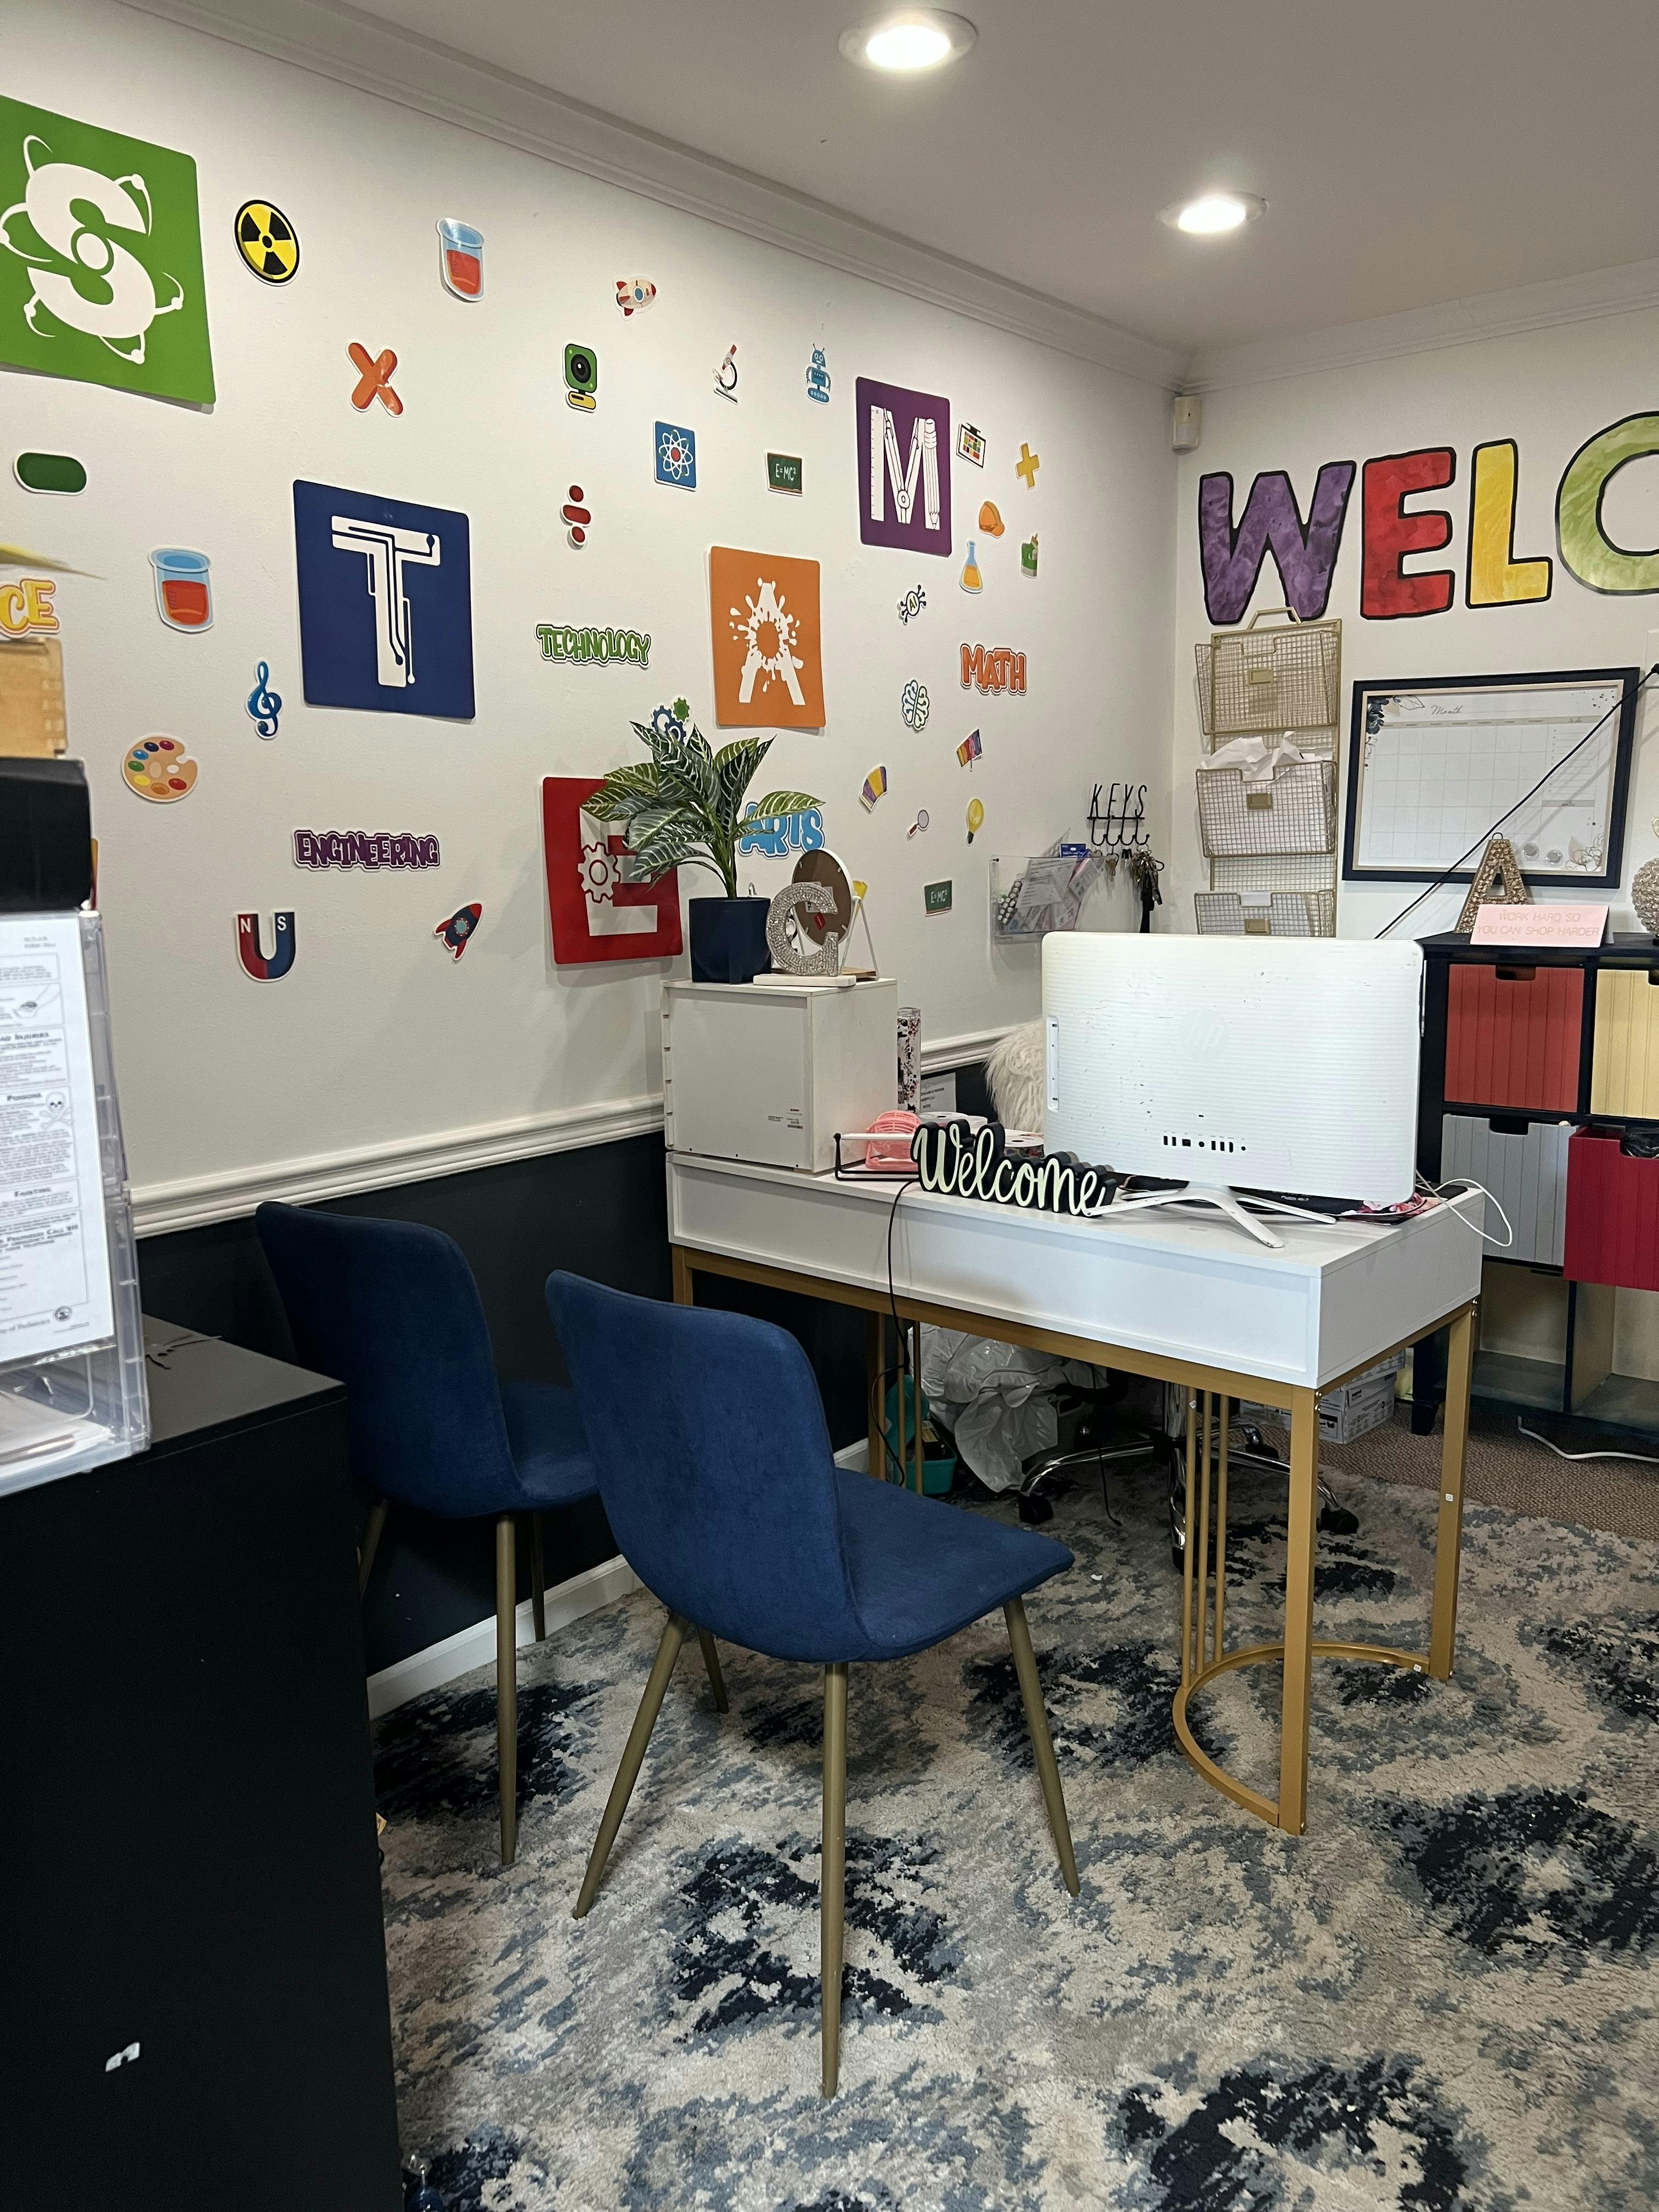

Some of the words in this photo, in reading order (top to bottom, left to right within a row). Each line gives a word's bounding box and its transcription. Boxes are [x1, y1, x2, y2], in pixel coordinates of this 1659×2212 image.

[332, 516, 440, 687] T
[909, 595, 918, 612] AI
[537, 627, 650, 664] TECHNOLOGY
[731, 579, 806, 706] A
[961, 644, 1026, 693] MATH
[1088, 783, 1147, 820] KEYS
[296, 830, 439, 868] ENGINEERING
[240, 918, 251, 934] N
[277, 915, 287, 930] S
[1477, 926, 1498, 934] YOU
[1500, 926, 1521, 935] CAN
[1525, 926, 1554, 935] SHOP
[1557, 927, 1599, 936] HARDER
[1499, 912, 1528, 922] WORK
[1533, 912, 1561, 922] HARD
[1565, 912, 1581, 922] SO
[915, 1125, 1108, 1217] Welcome
